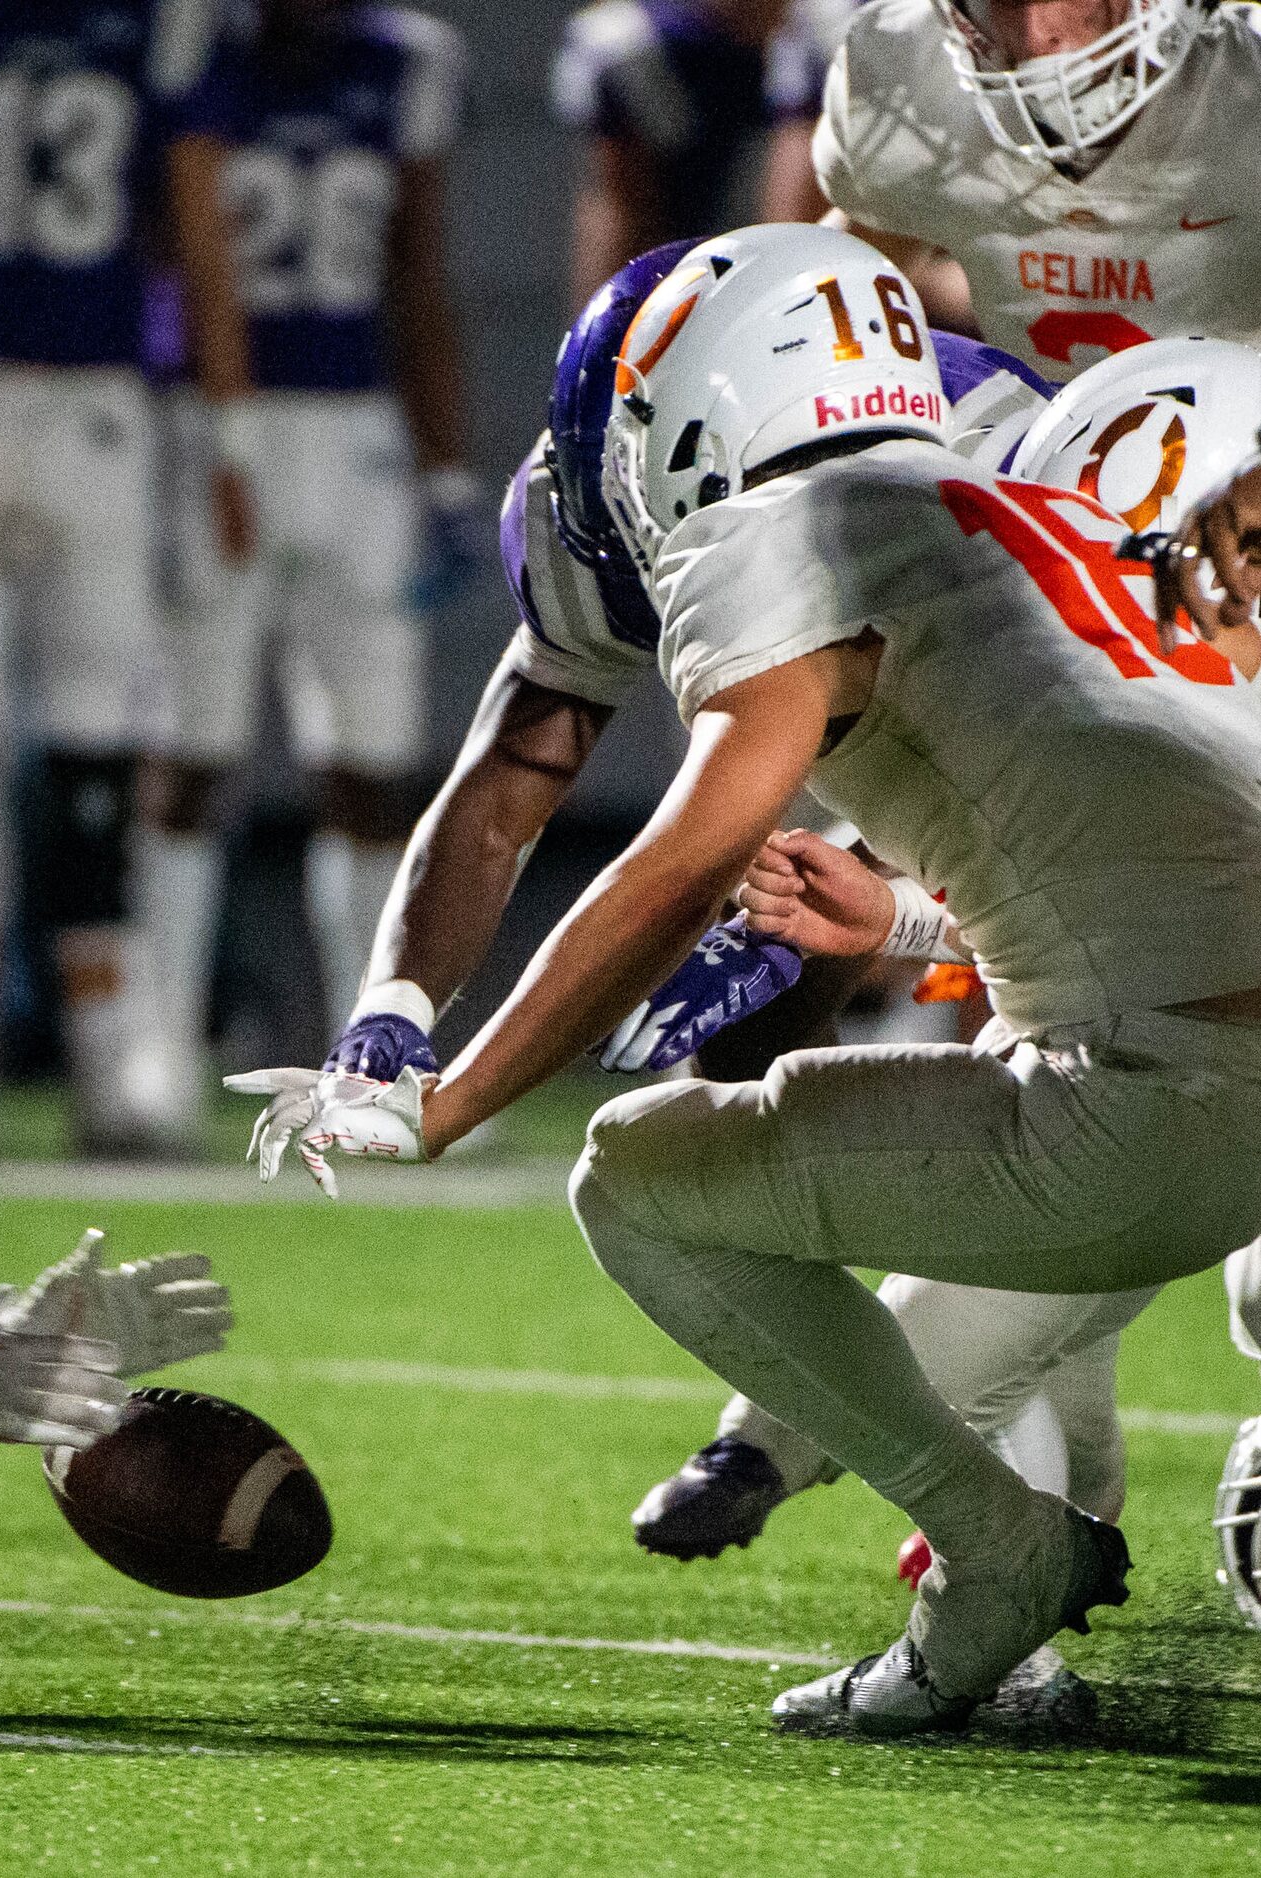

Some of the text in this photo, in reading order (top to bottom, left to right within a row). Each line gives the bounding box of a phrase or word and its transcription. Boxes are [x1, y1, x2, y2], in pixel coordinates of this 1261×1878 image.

[216, 148, 396, 312] 26
[1018, 250, 1155, 301] CELINA
[816, 273, 923, 363] 16
[814, 384, 941, 429] Riddell
